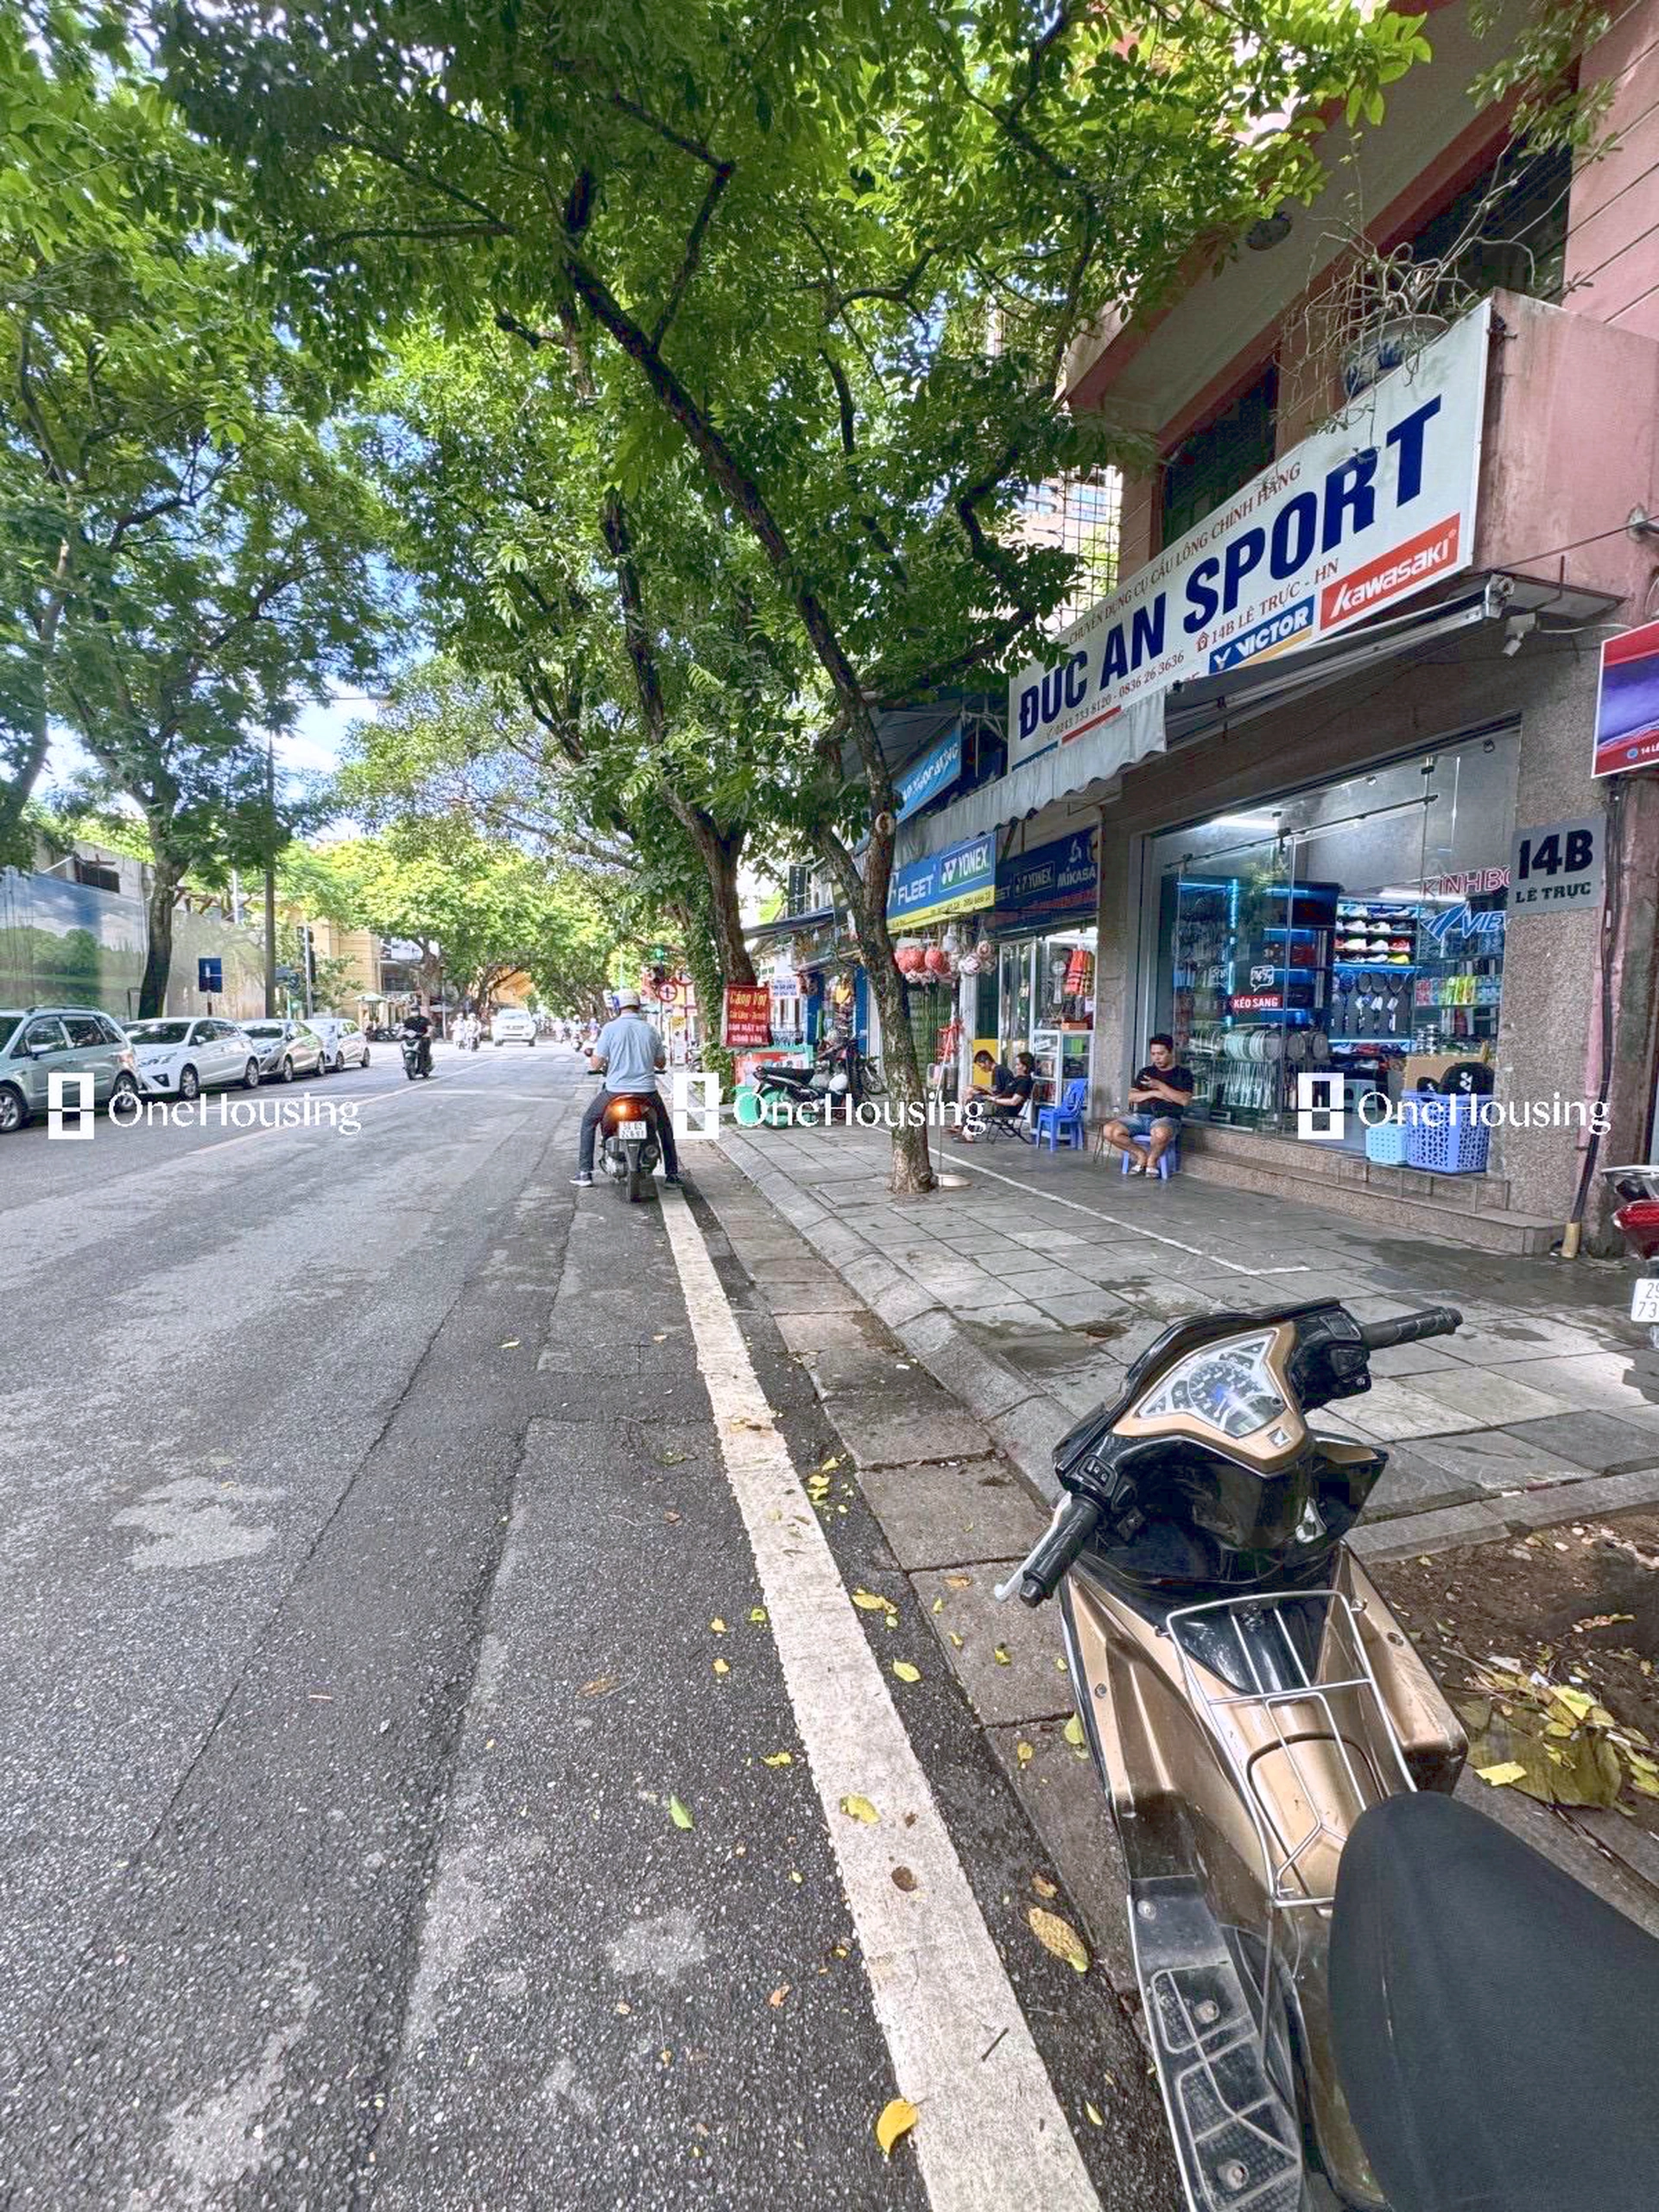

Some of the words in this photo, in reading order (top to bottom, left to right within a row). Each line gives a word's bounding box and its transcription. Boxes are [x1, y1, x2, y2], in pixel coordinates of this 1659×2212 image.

[1212, 500, 1253, 540] CHÍNH
[1099, 592, 1166, 691] AN
[1183, 394, 1441, 634] SPORT
[1212, 619, 1235, 645] 14B
[1314, 558, 1339, 586] HN
[1236, 605, 1310, 657] VICTOR
[1158, 650, 1185, 675] 3636
[959, 844, 988, 878] YONEX
[1518, 829, 1593, 879] 14B
[897, 874, 934, 905] FLEET
[1516, 887, 1537, 903] LÊ
[1542, 882, 1591, 900] TRỰC
[1233, 996, 1251, 1009] KÉO
[1252, 996, 1278, 1008] SANG
